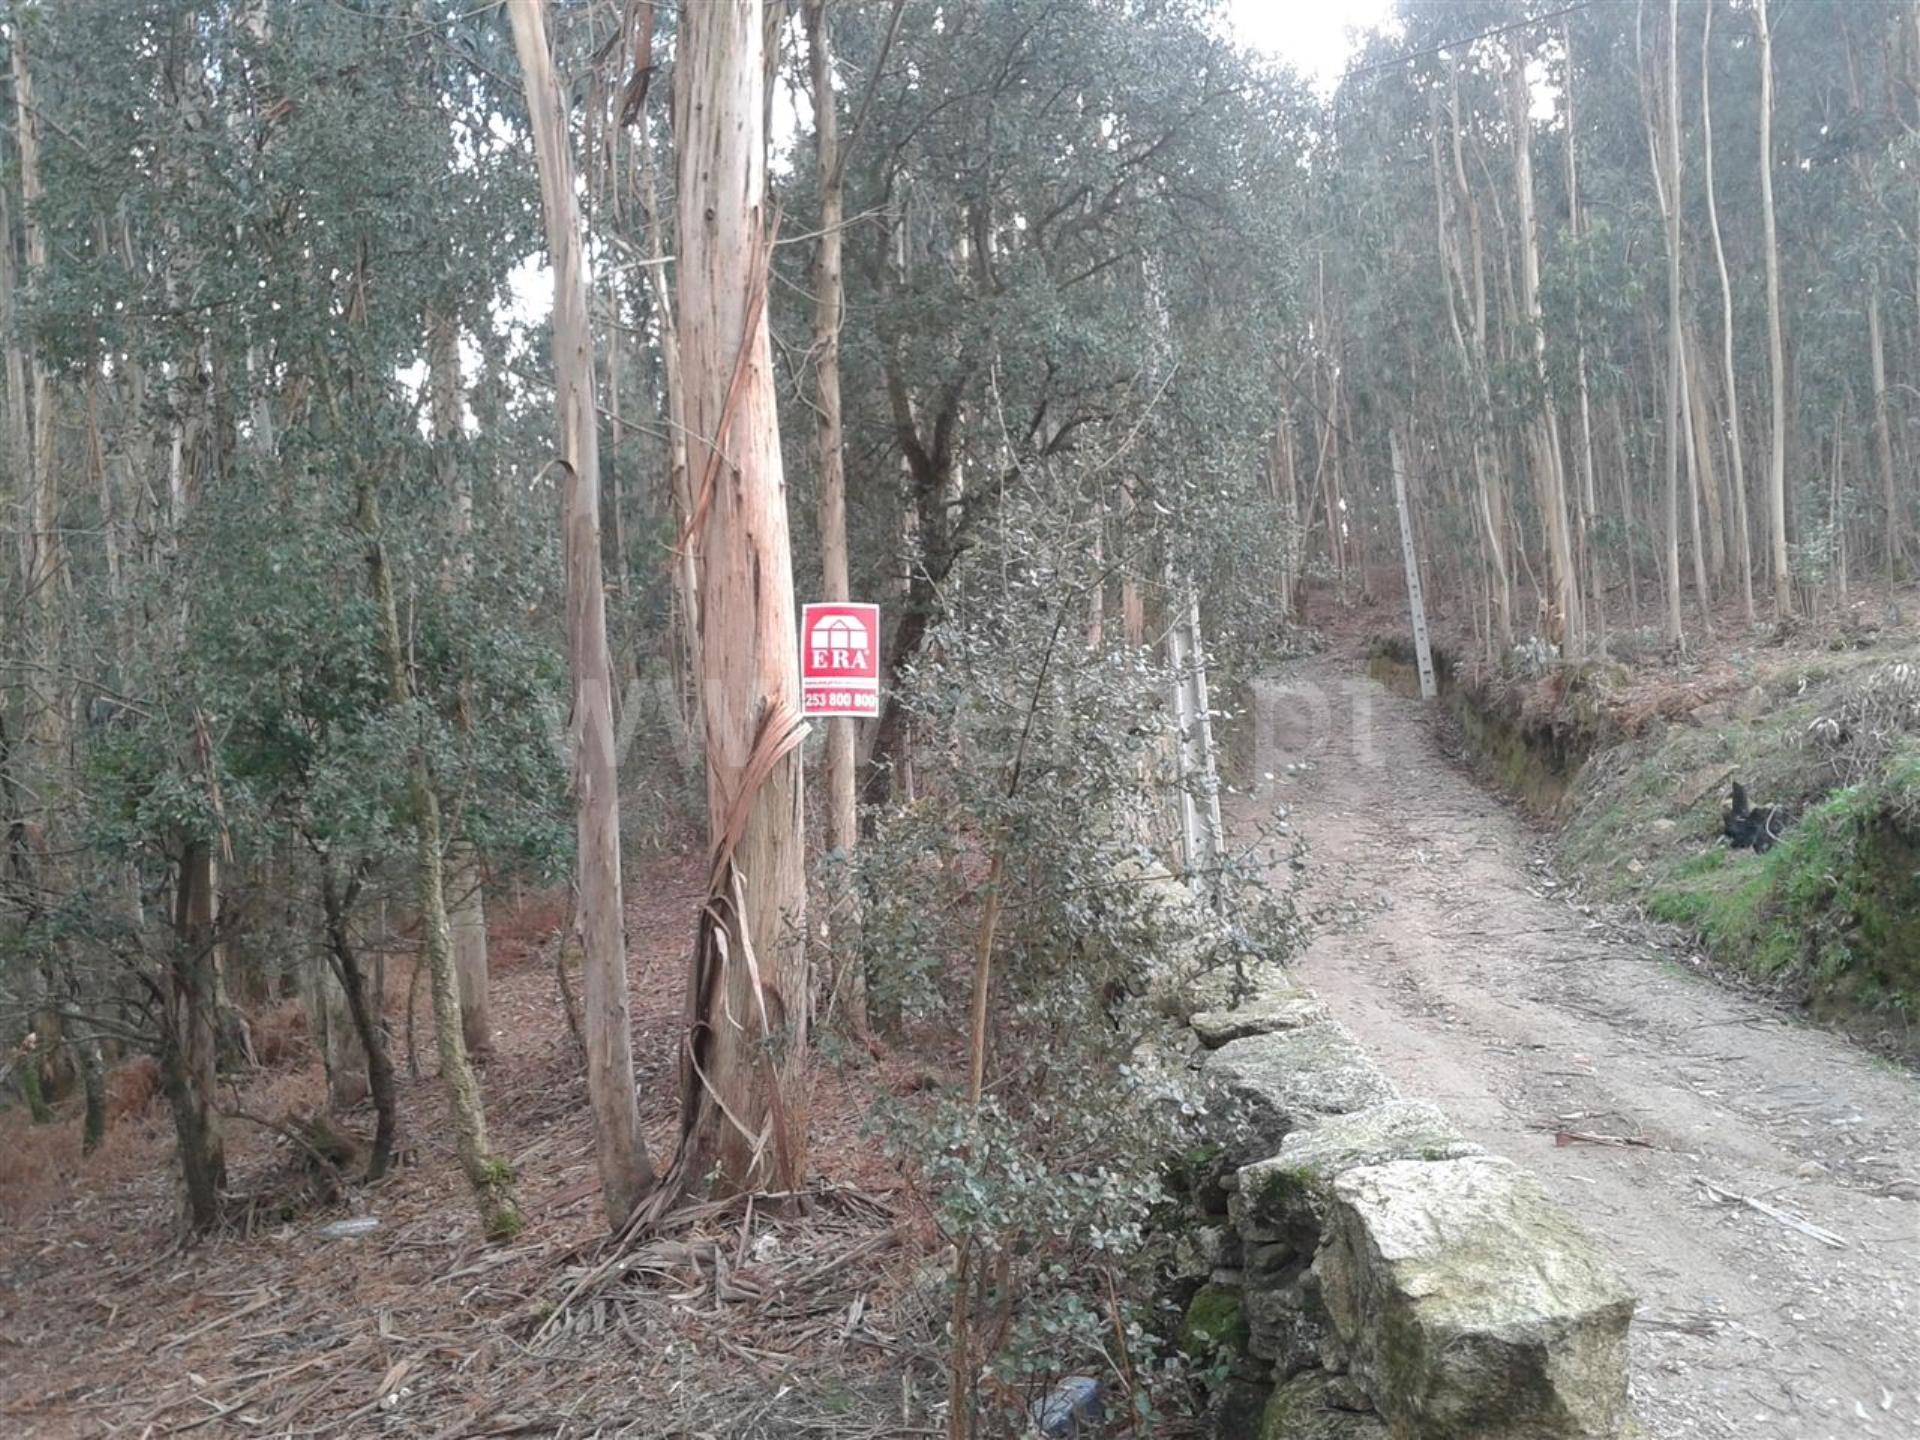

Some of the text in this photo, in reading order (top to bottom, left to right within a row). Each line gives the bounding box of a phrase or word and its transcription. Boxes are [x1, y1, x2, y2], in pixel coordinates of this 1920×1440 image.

[812, 649, 868, 669] ERA
[806, 692, 876, 707] 253 800 800
